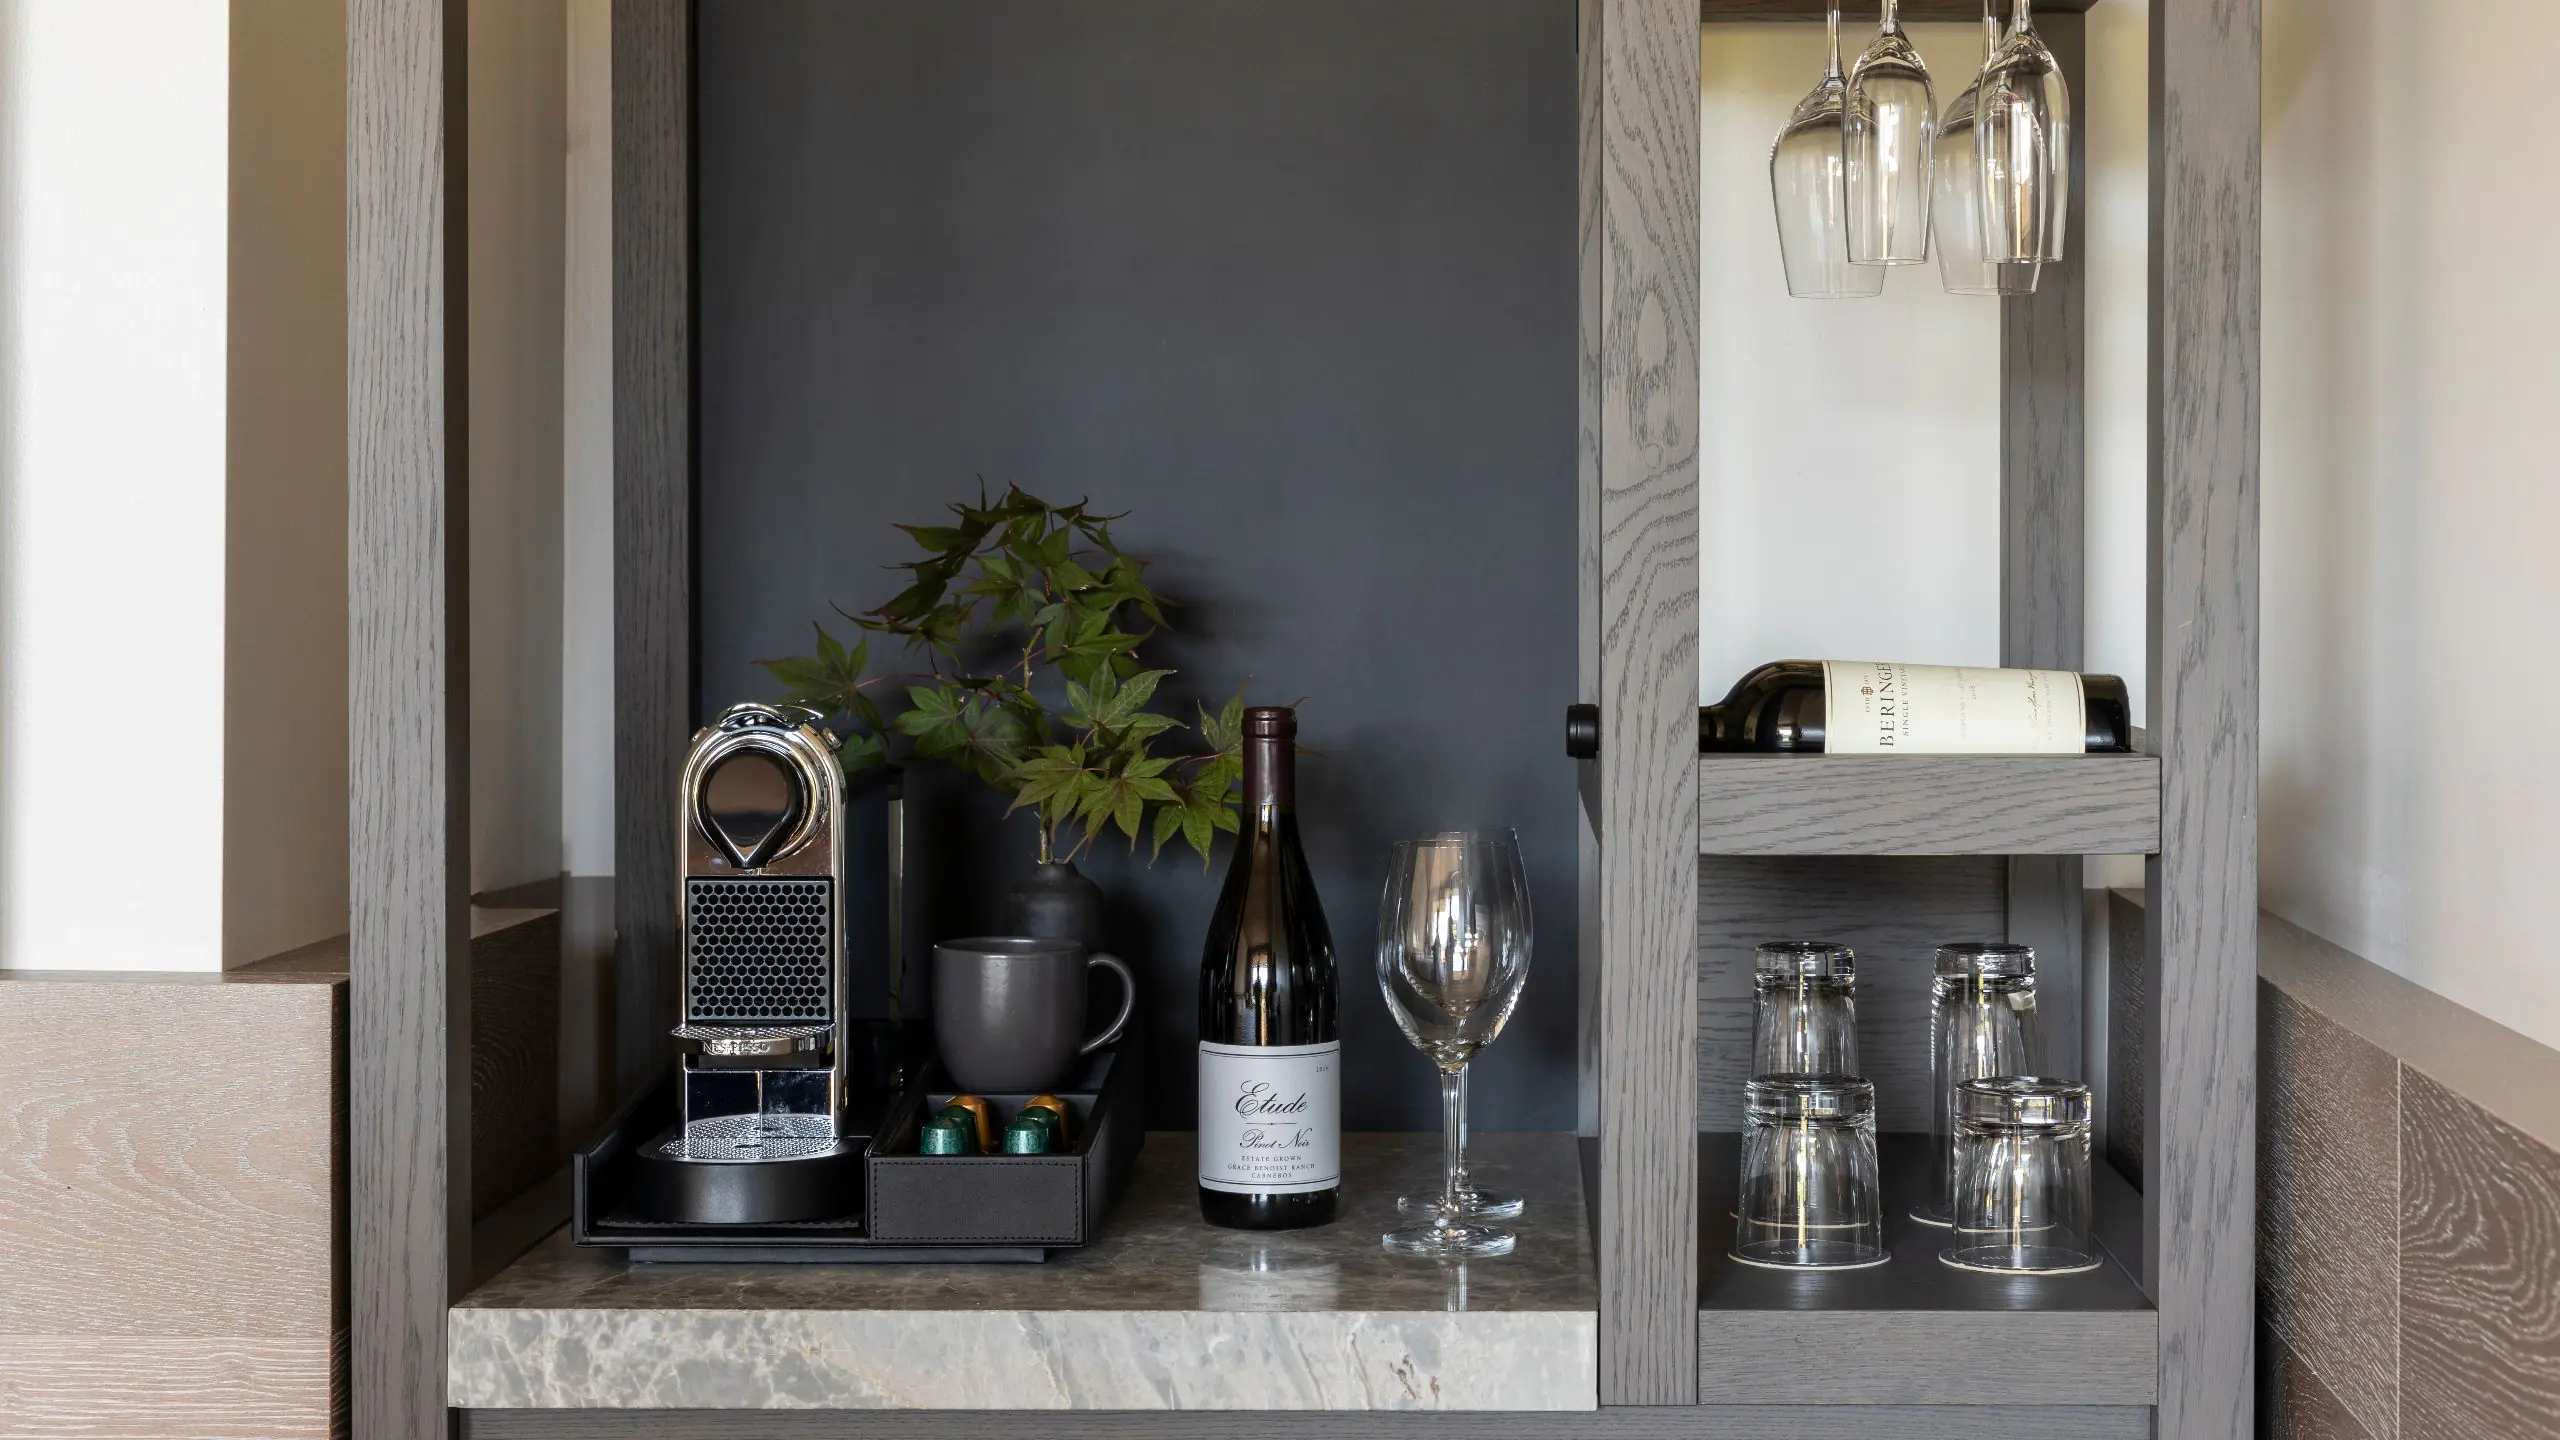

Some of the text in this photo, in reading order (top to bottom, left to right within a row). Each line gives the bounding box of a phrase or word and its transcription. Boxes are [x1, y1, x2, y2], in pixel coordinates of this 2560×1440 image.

[1235, 1079, 1308, 1119] Etude
[1240, 1127, 1313, 1149] Pinot Noir
[1227, 1163, 1251, 1171] GRACE
[1291, 1163, 1315, 1171] RANCH
